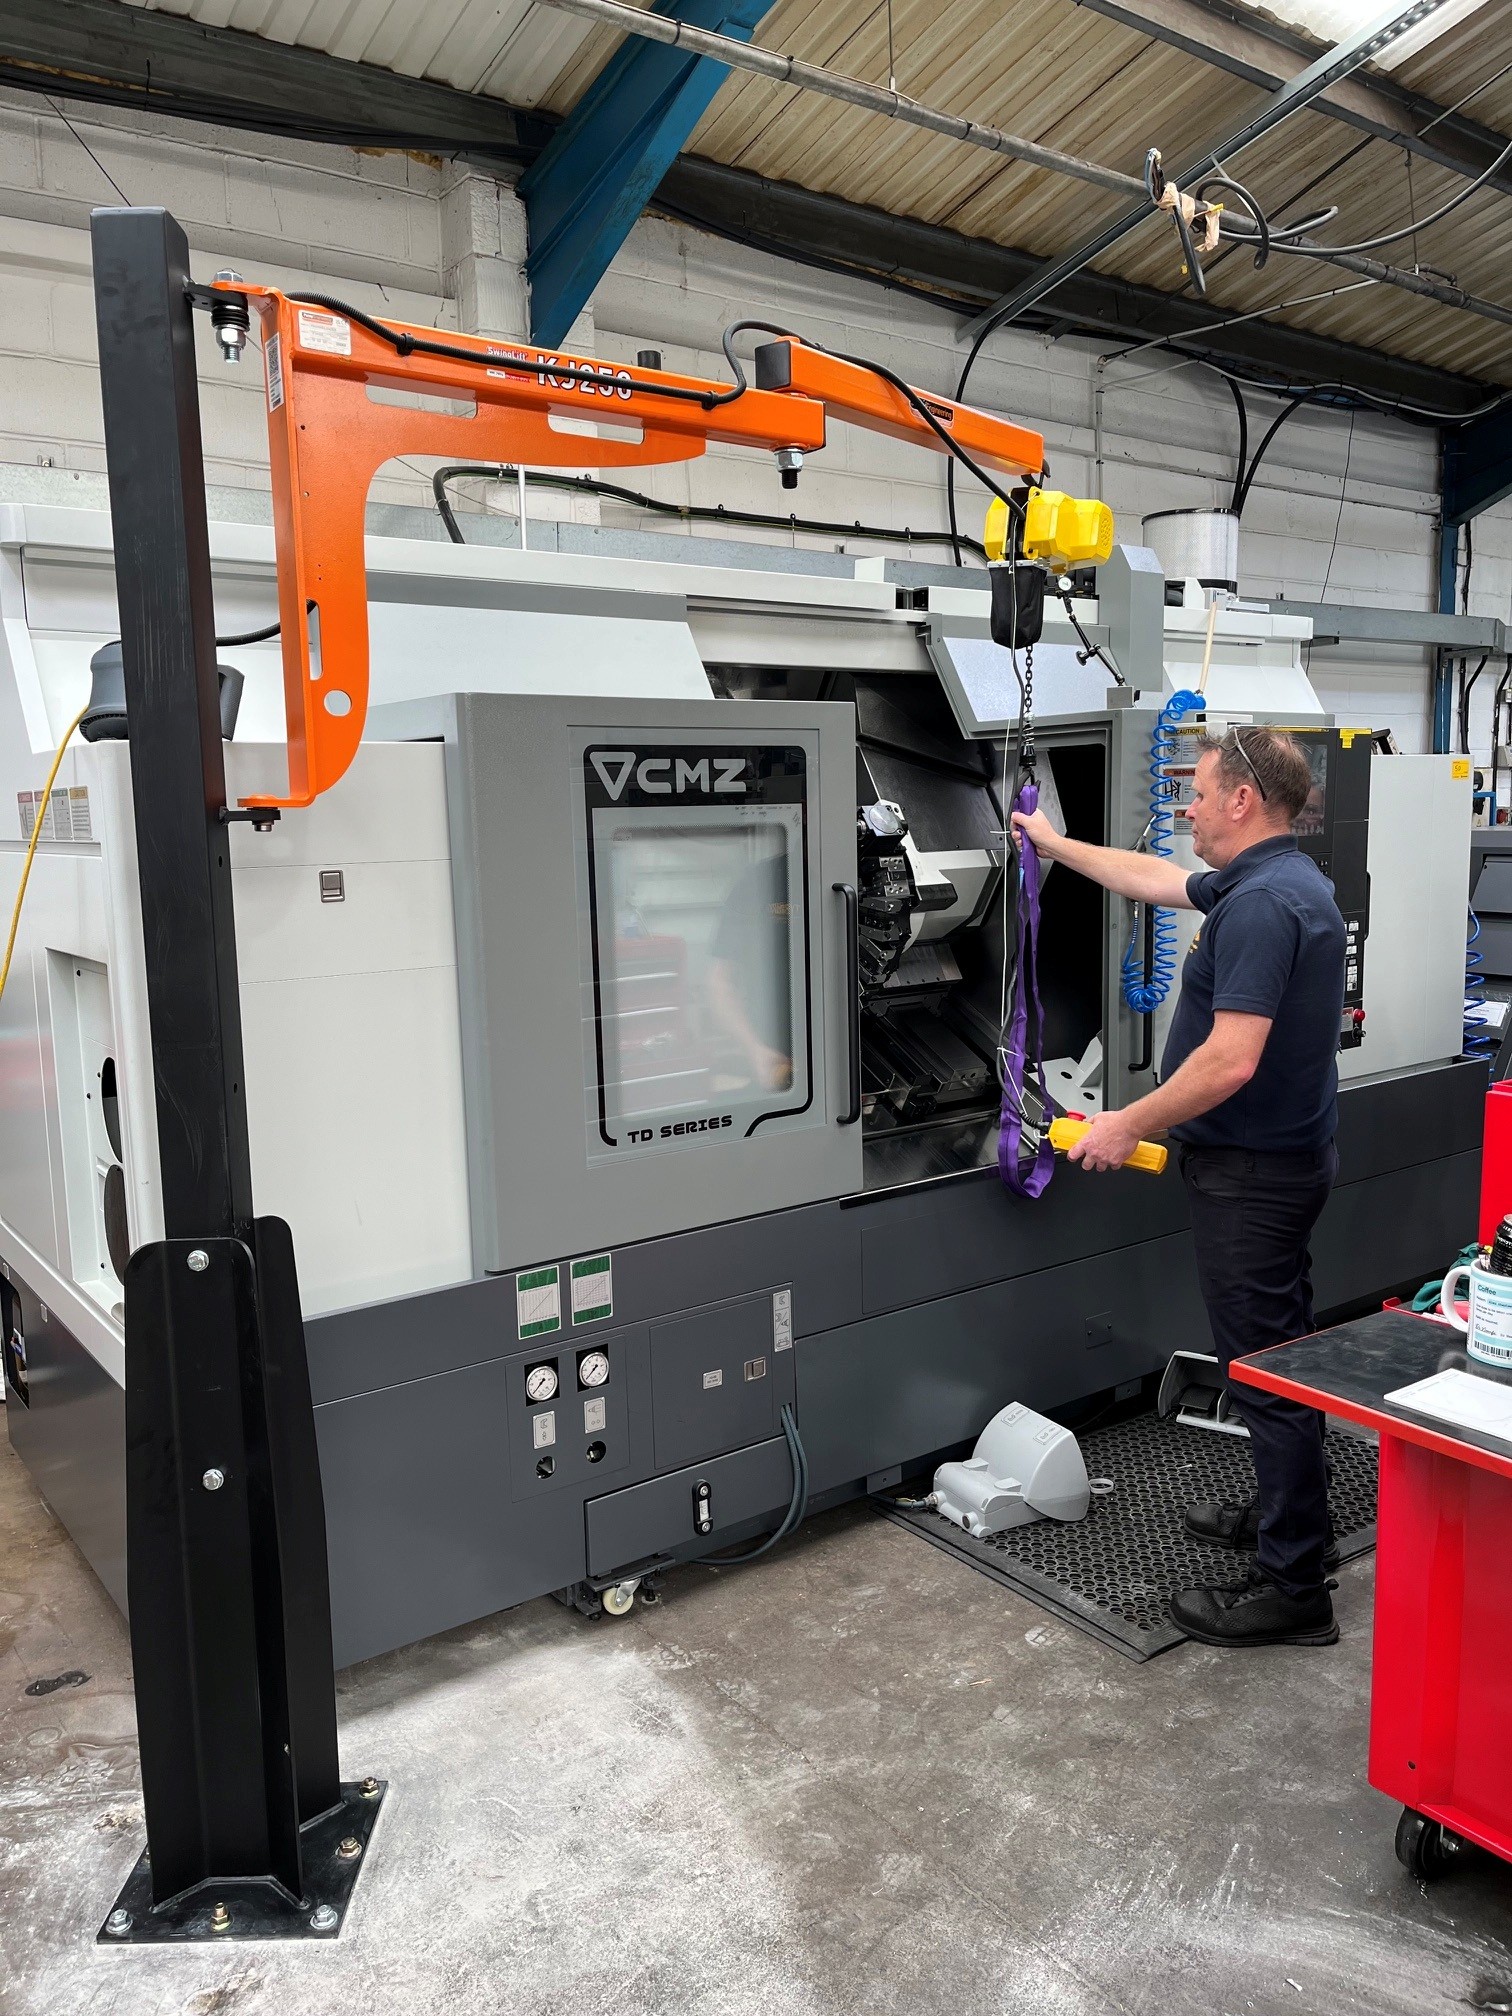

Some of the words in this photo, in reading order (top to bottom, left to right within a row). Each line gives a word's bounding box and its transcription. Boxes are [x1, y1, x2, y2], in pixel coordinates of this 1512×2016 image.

[537, 354, 633, 400] KJ250
[636, 758, 747, 793] CMZ
[627, 1128, 653, 1143] TD
[660, 1115, 733, 1138] SERIES
[1477, 1284, 1497, 1296] Coffee
